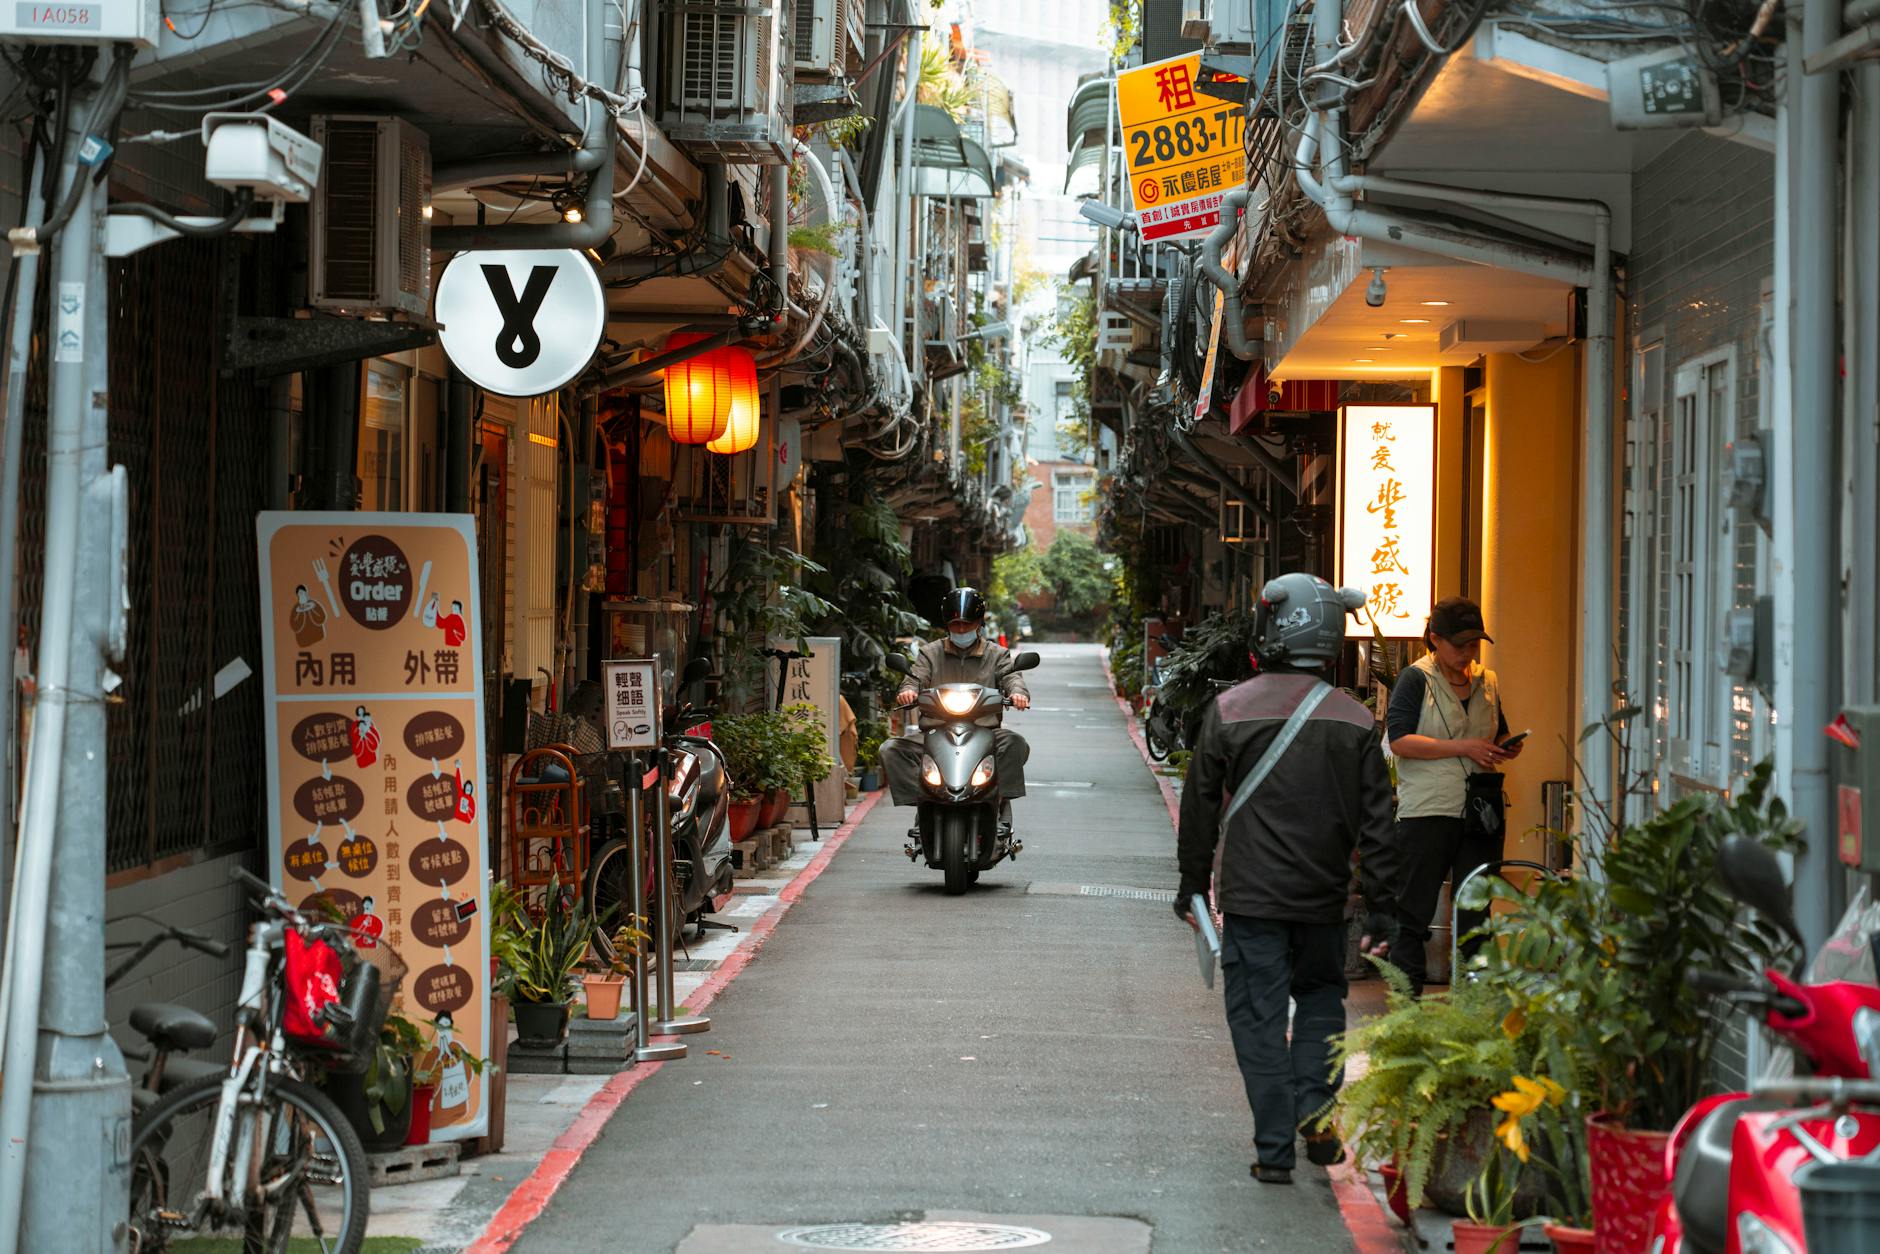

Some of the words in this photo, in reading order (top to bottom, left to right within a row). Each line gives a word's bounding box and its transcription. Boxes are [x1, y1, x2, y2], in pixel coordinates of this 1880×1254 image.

[1154, 64, 1196, 112] 租
[1162, 165, 1222, 197] 永慶房屋
[350, 581, 403, 600] Order
[296, 651, 355, 687] 內用
[404, 650, 459, 685] 外帶
[615, 672, 642, 688] 輕聲
[616, 689, 644, 705] 細語
